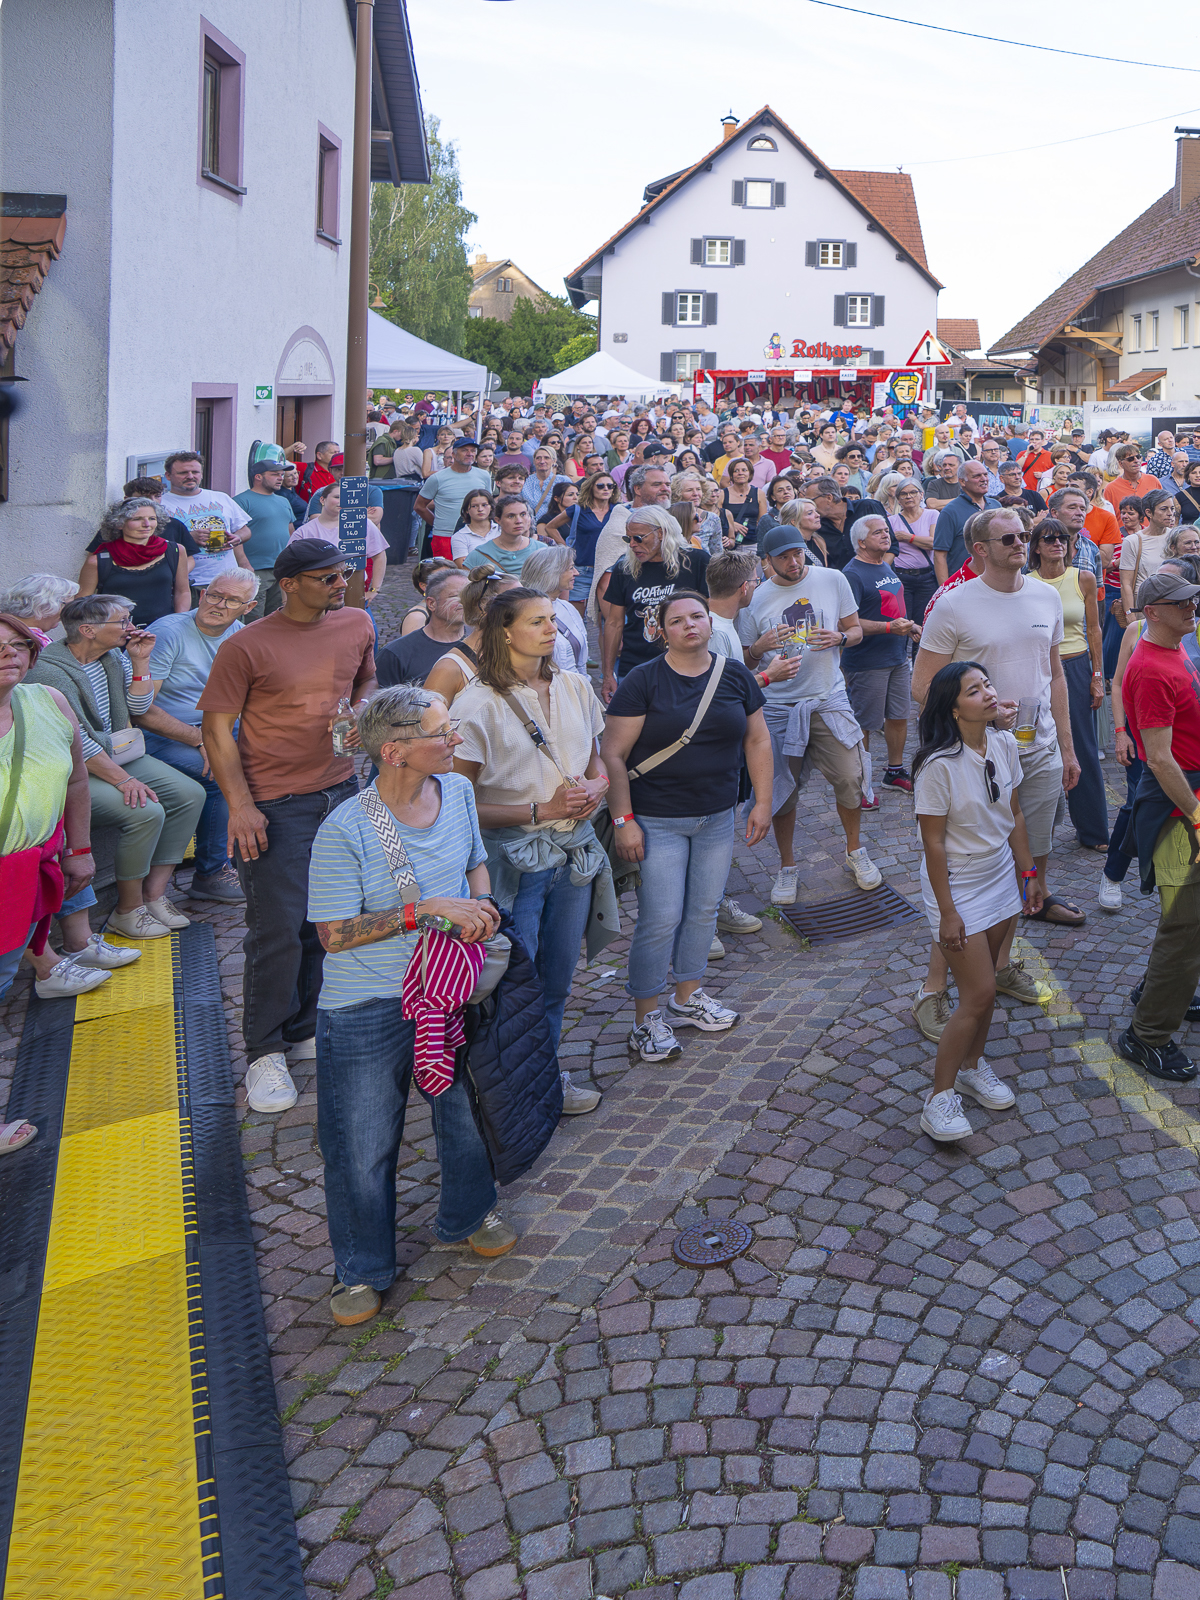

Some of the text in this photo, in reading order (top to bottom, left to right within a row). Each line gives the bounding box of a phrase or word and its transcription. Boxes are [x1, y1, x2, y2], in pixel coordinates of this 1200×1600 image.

[790, 339, 862, 361] Rothaus
[1092, 403, 1132, 414] Breitenfeld
[1141, 404, 1157, 412] alten
[1158, 402, 1177, 412] Zeiten
